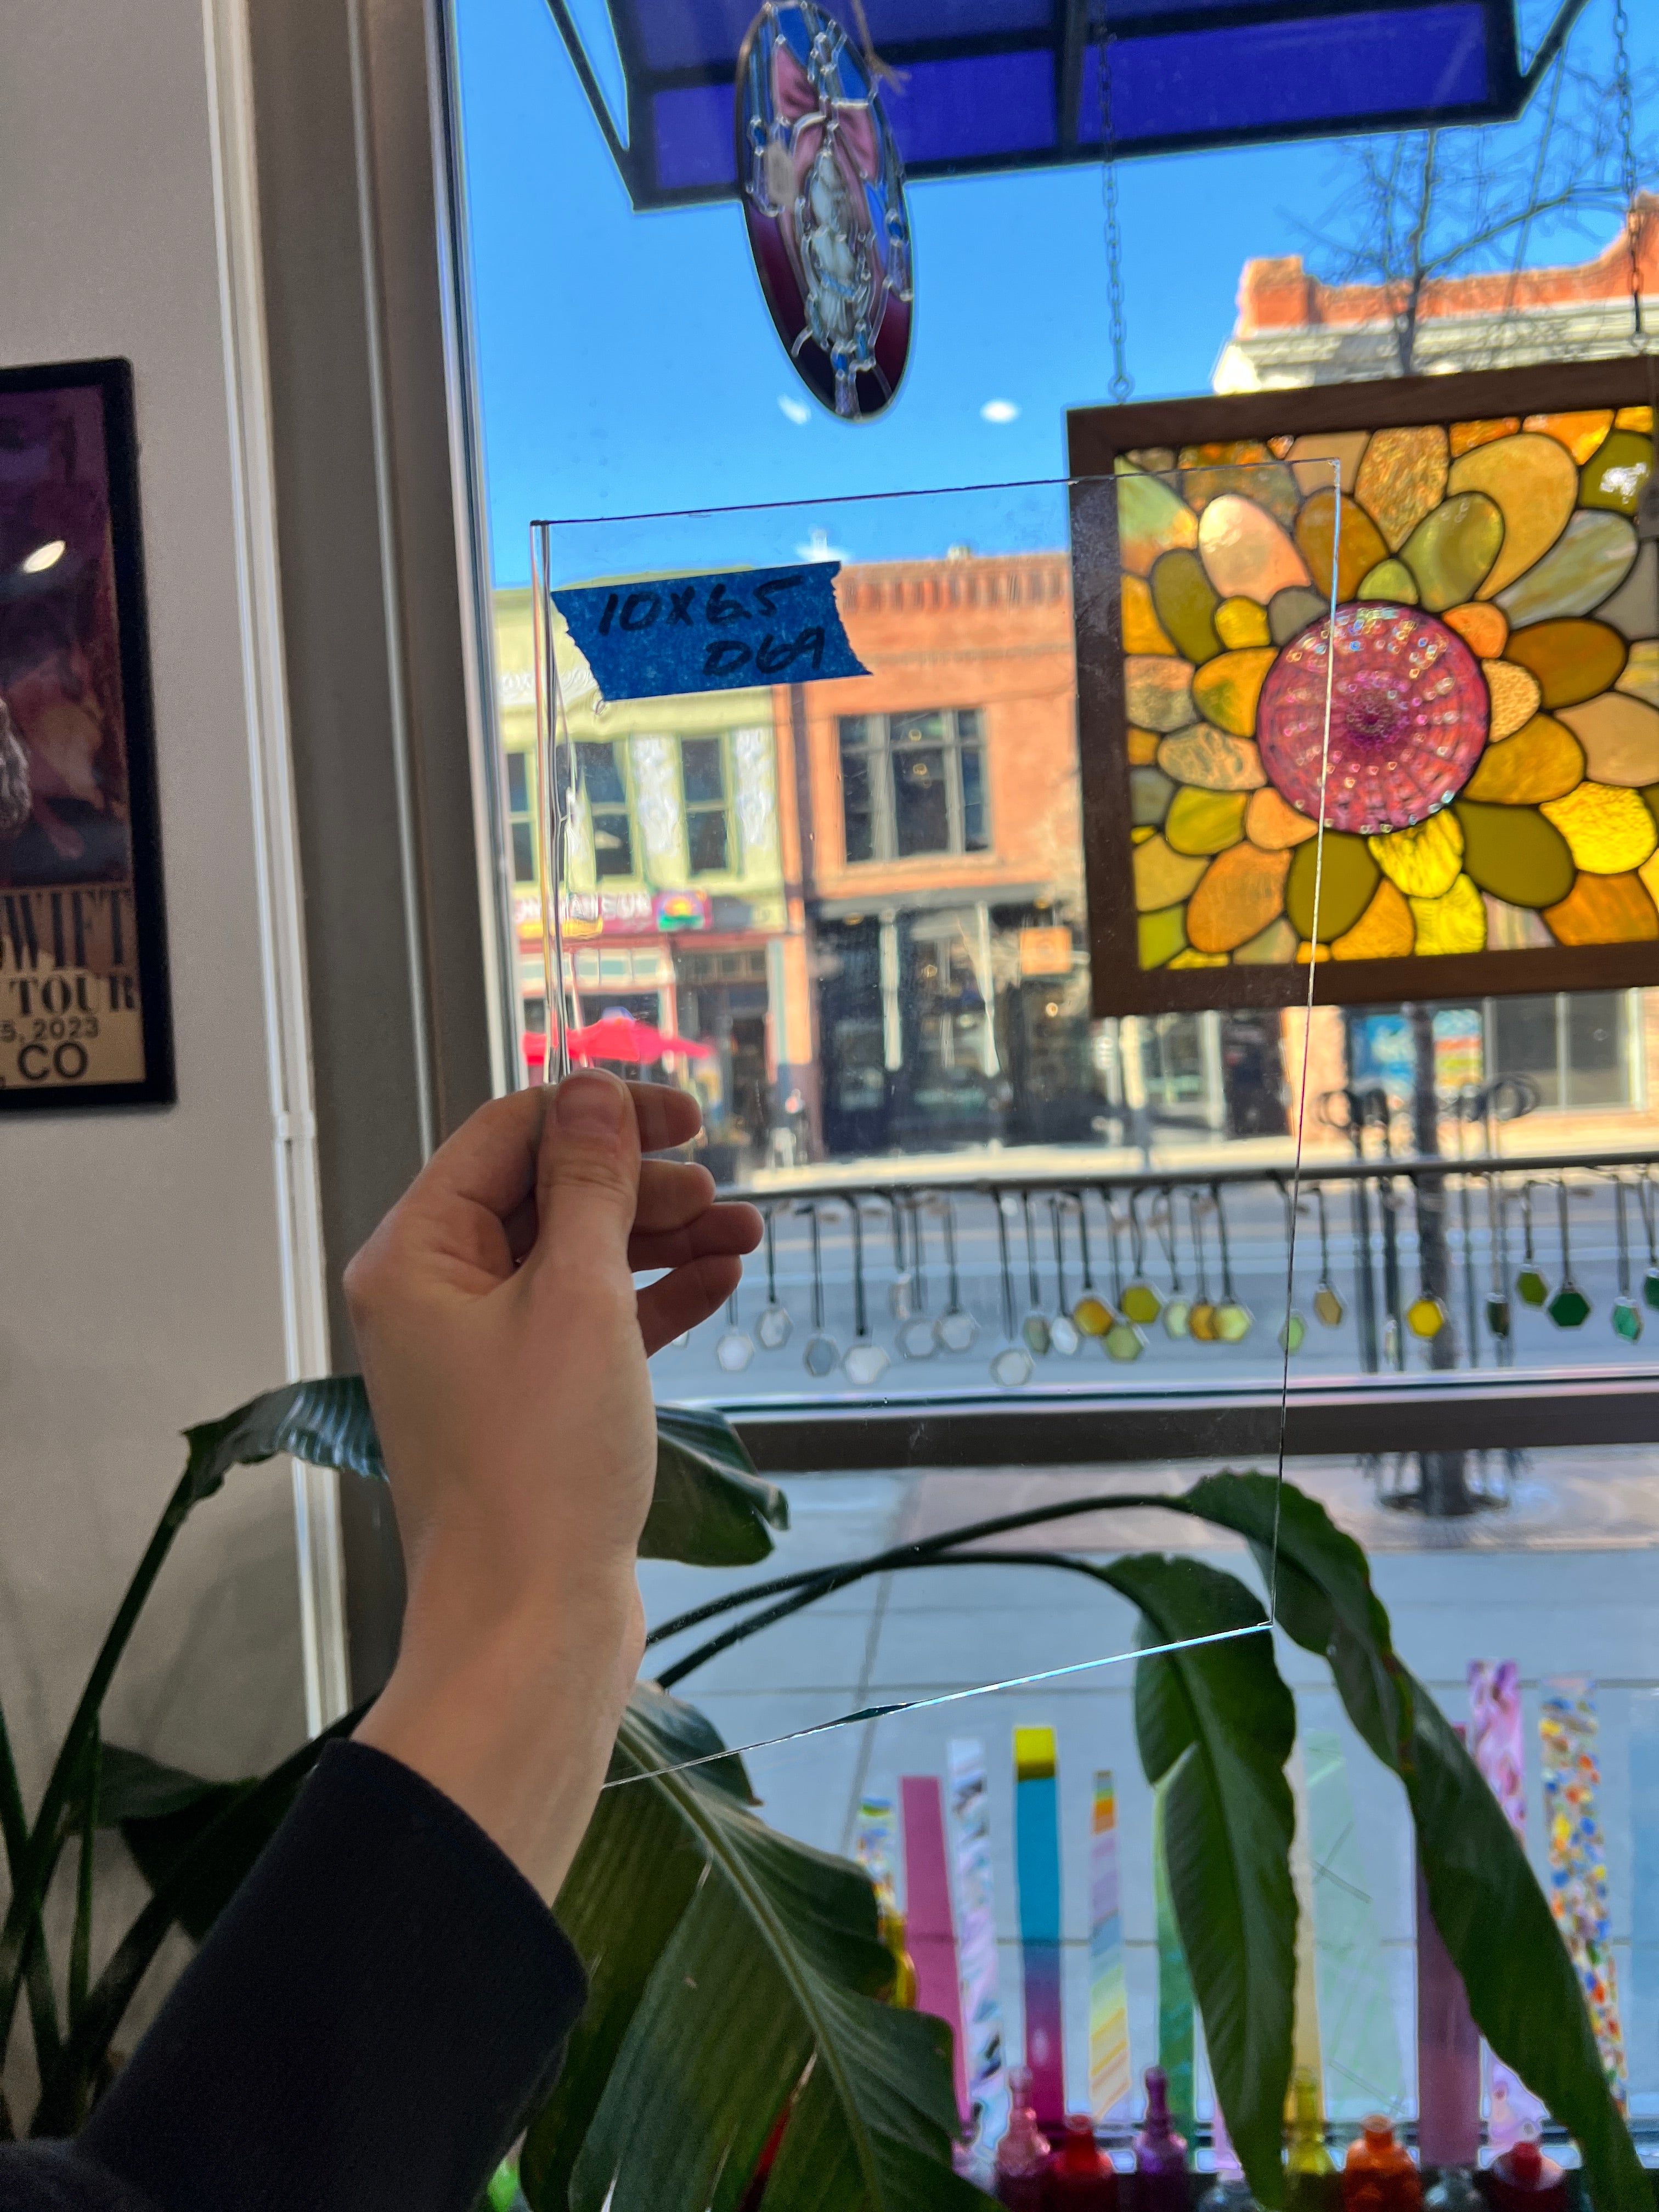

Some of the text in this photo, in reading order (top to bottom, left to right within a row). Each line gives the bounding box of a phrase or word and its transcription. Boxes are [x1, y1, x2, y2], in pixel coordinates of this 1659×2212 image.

[9, 974, 134, 1016] TOUR
[32, 1015, 99, 1040] 2023
[18, 1042, 88, 1080] CO
